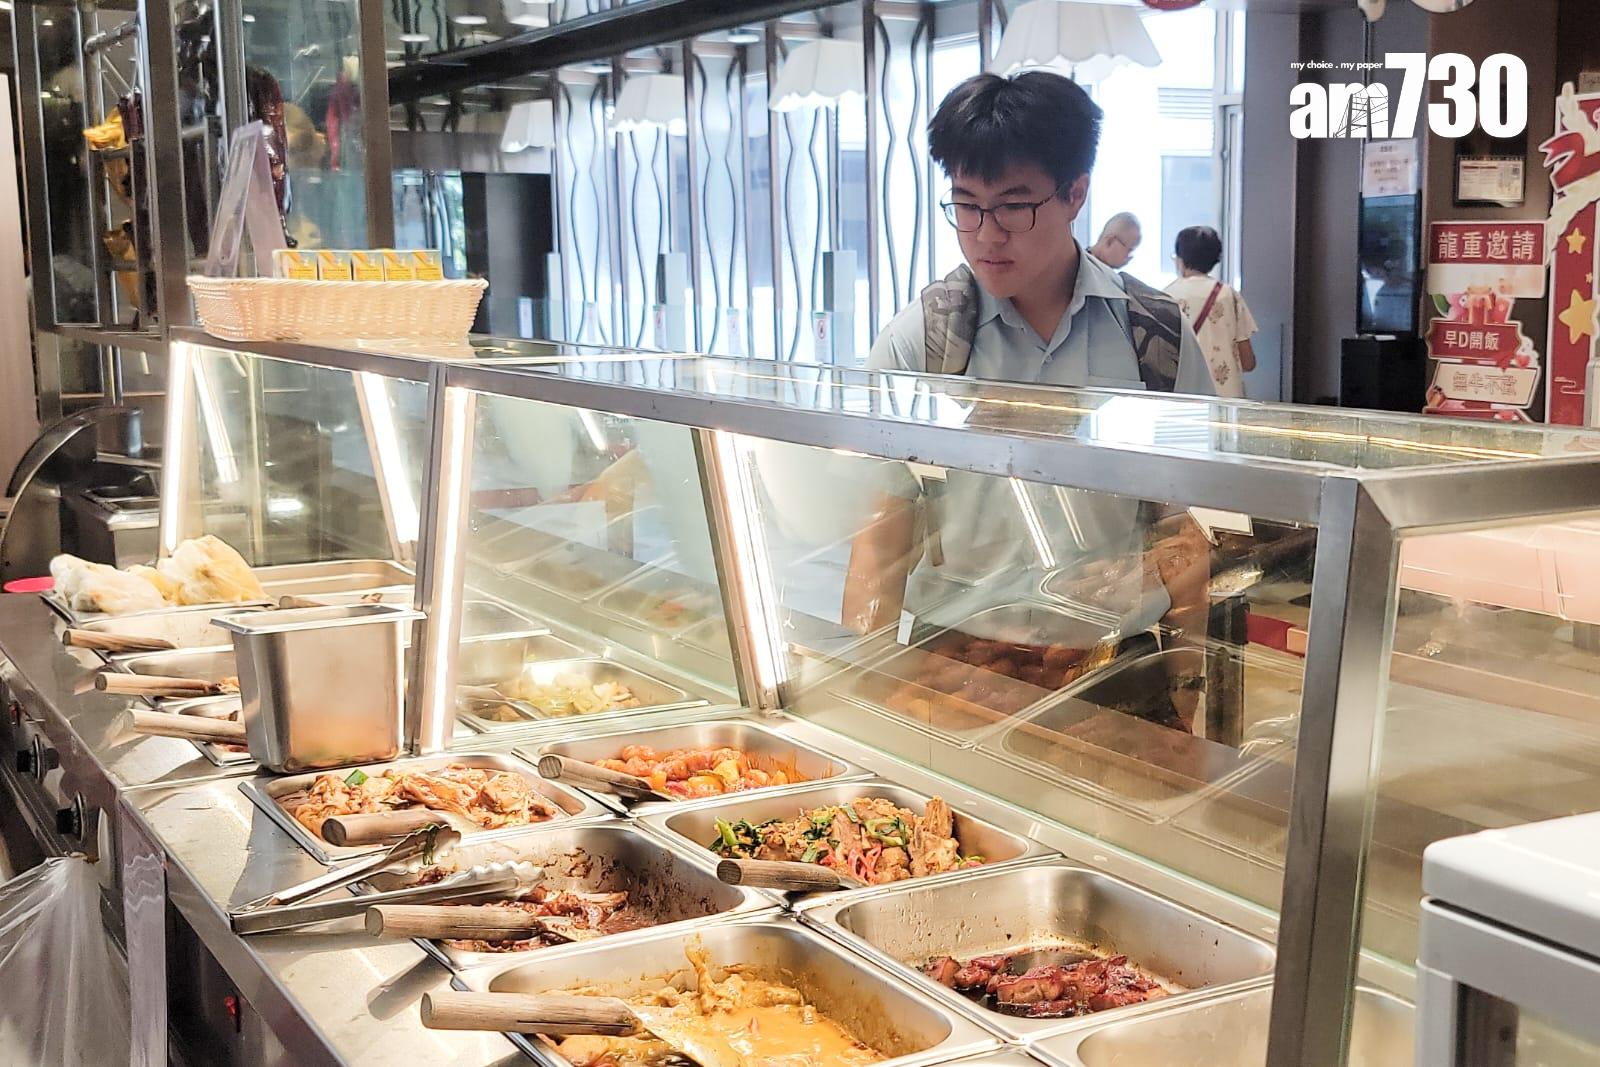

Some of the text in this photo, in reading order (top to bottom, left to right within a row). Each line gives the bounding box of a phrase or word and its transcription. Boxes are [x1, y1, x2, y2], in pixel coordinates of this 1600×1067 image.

[1438, 230, 1535, 259] 龍重邀請
[1443, 330, 1500, 350] 早D開飯
